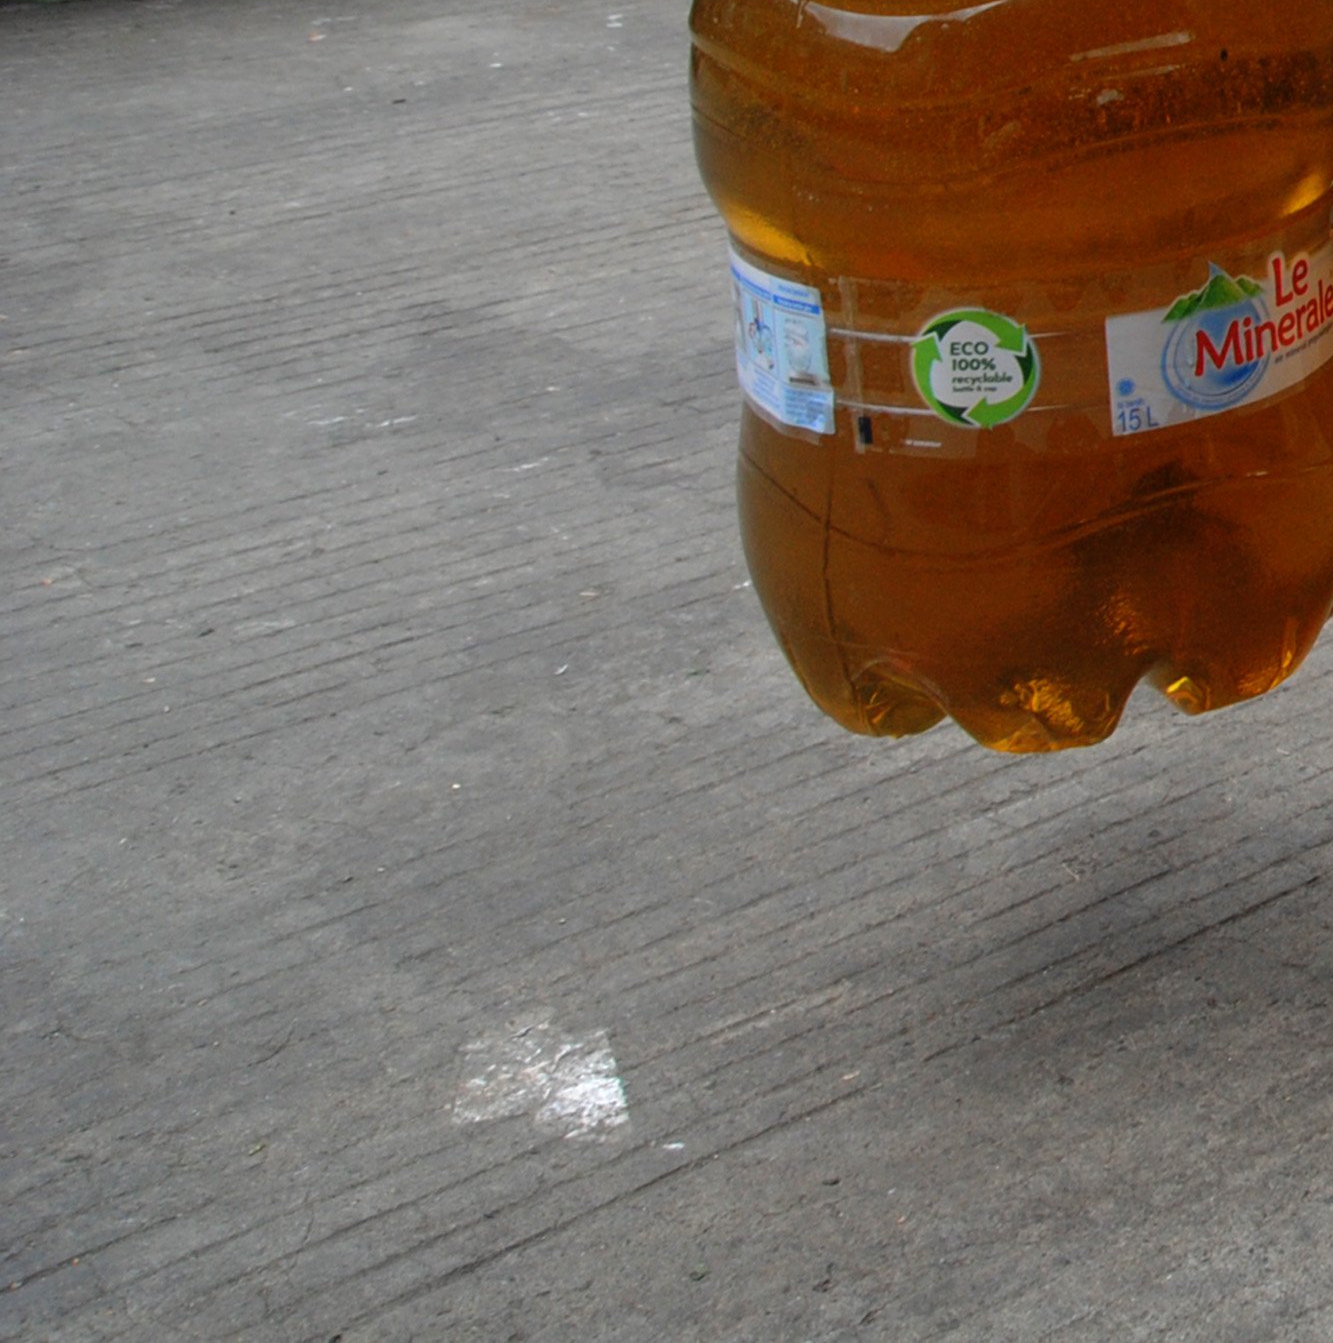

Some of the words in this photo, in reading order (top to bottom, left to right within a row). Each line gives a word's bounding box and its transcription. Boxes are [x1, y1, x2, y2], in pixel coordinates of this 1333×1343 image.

[1272, 257, 1308, 307] Le
[950, 342, 989, 355] ECO
[951, 358, 997, 371] 100%
[952, 372, 1013, 385] recyclable
[1116, 407, 1142, 432] 15
[1146, 406, 1160, 428] L
